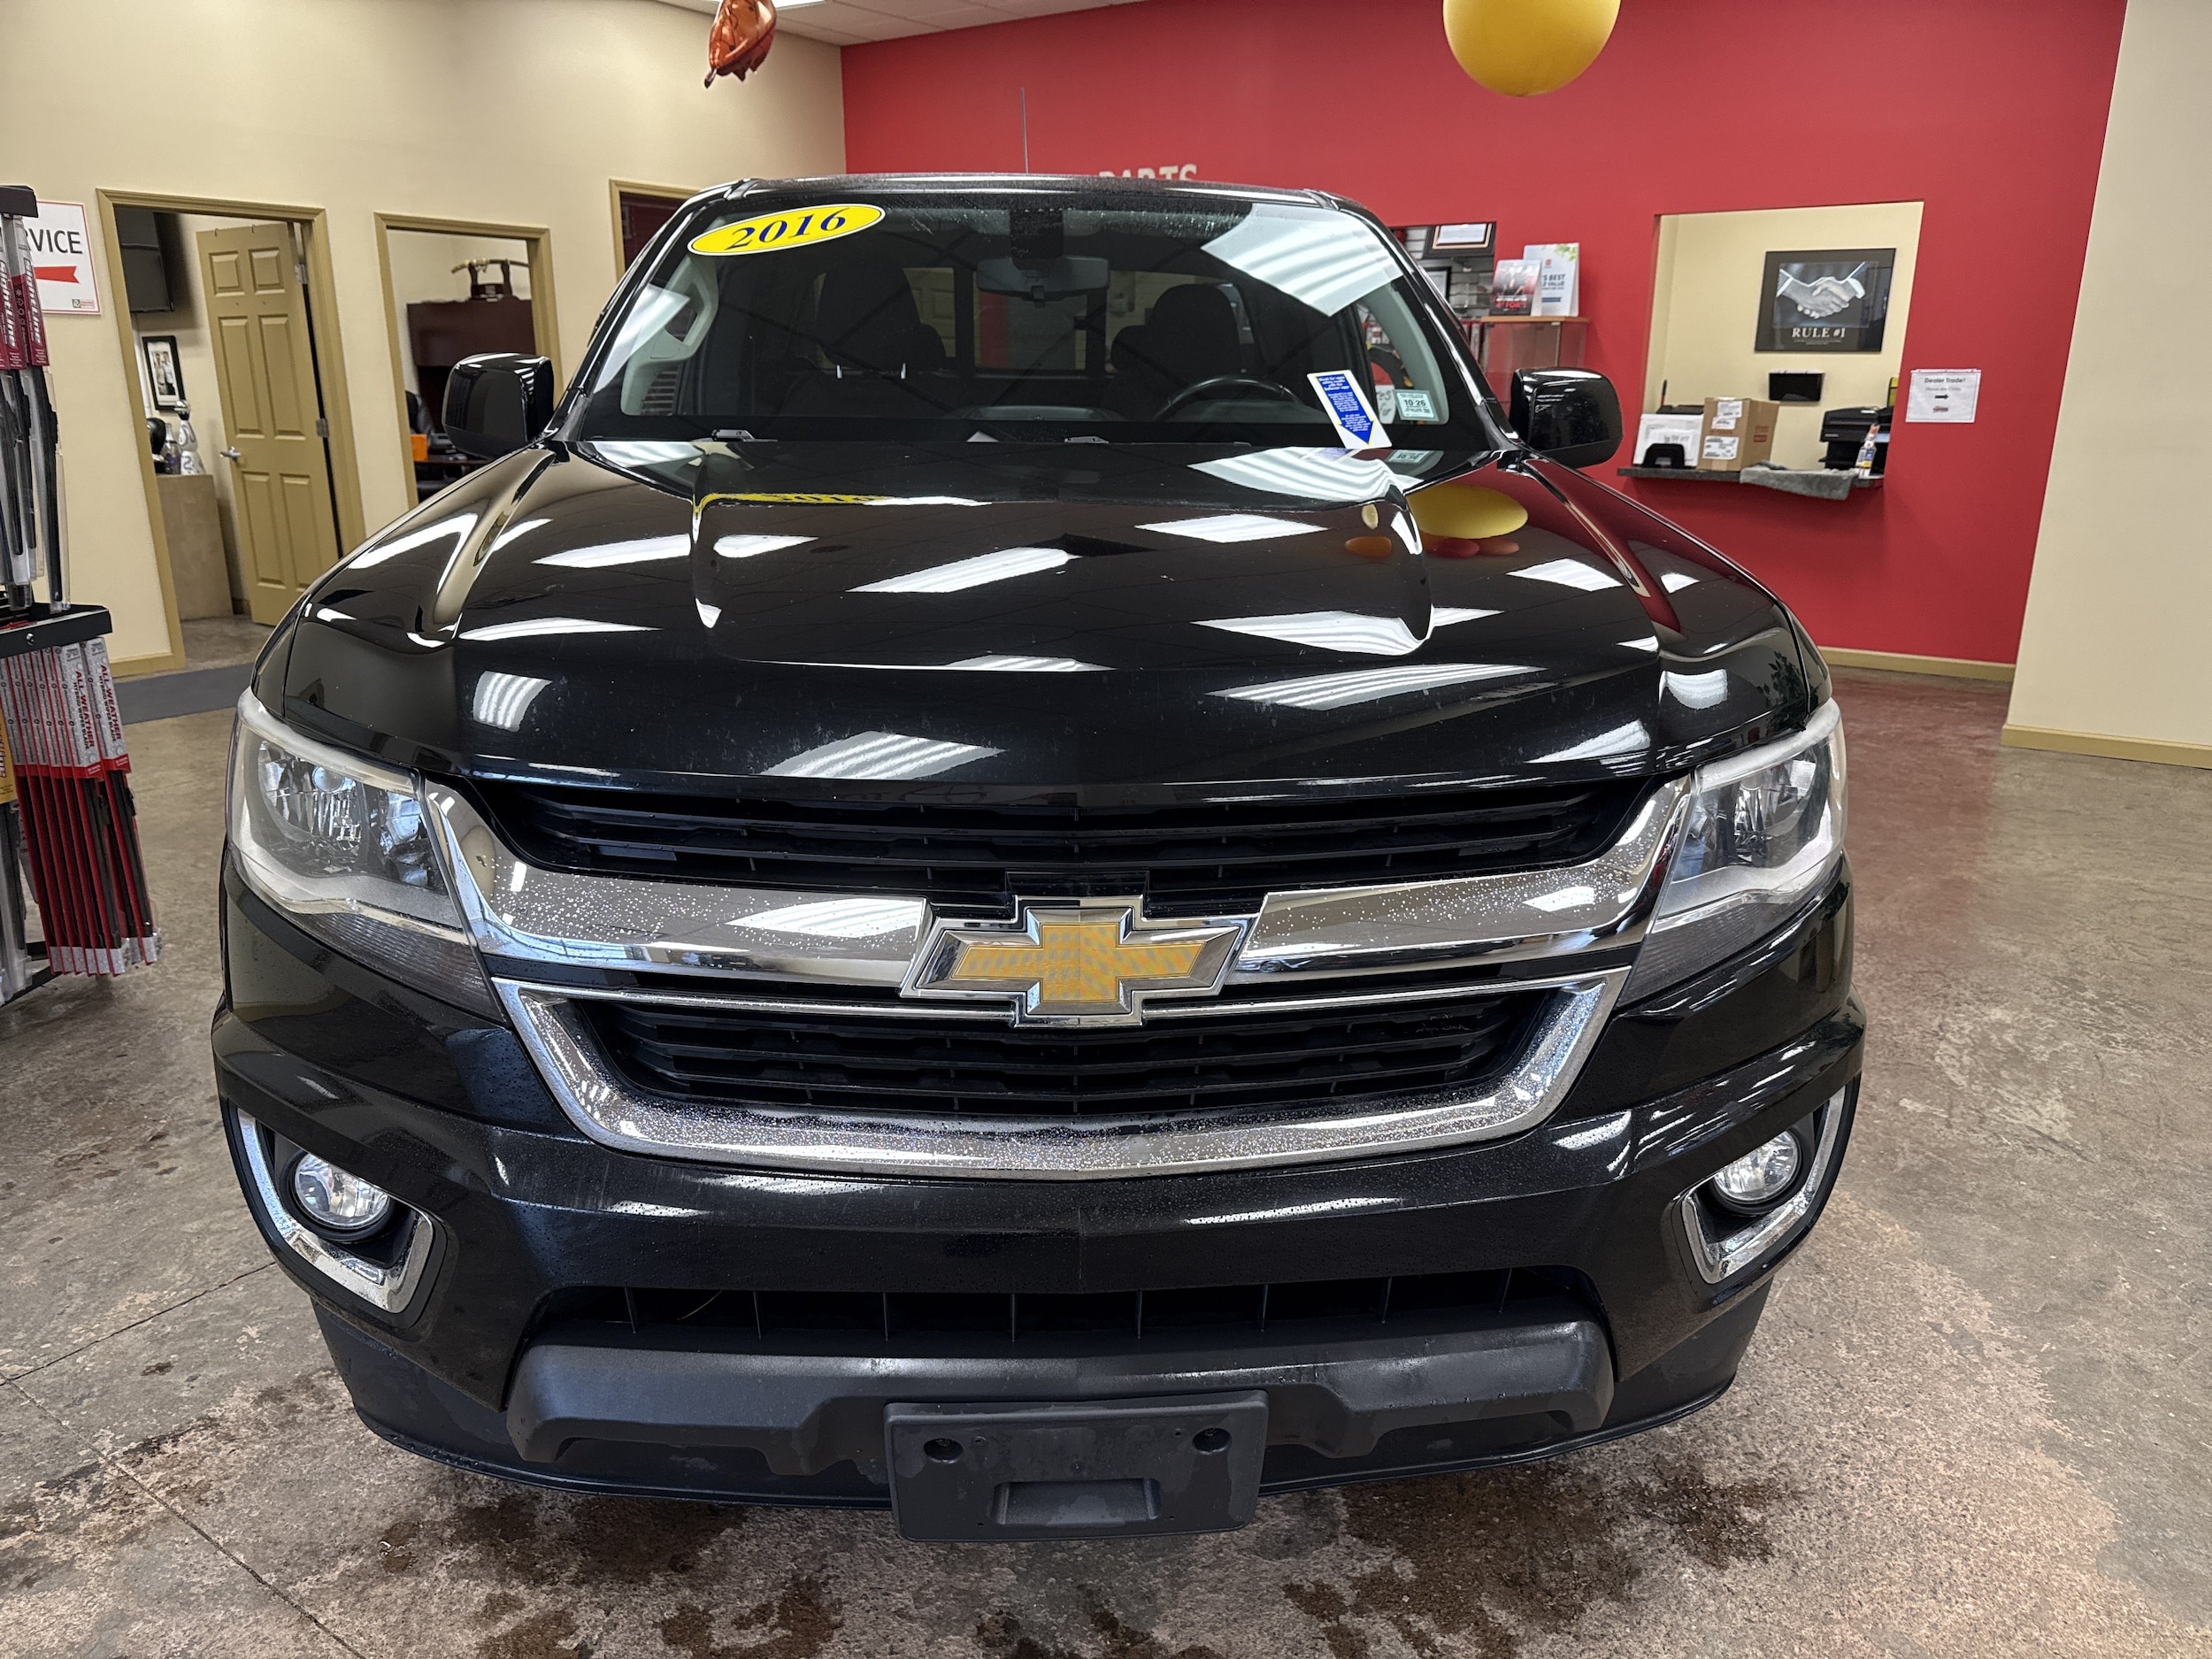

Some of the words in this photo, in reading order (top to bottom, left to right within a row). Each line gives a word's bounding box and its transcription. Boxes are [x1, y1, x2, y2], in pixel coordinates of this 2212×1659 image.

[26, 227, 83, 254] VICE
[725, 207, 850, 251] 2016
[1791, 326, 1831, 338] RULE
[75, 671, 95, 748] ALL-WEATHER
[100, 664, 121, 740] ALL-WEATHER
